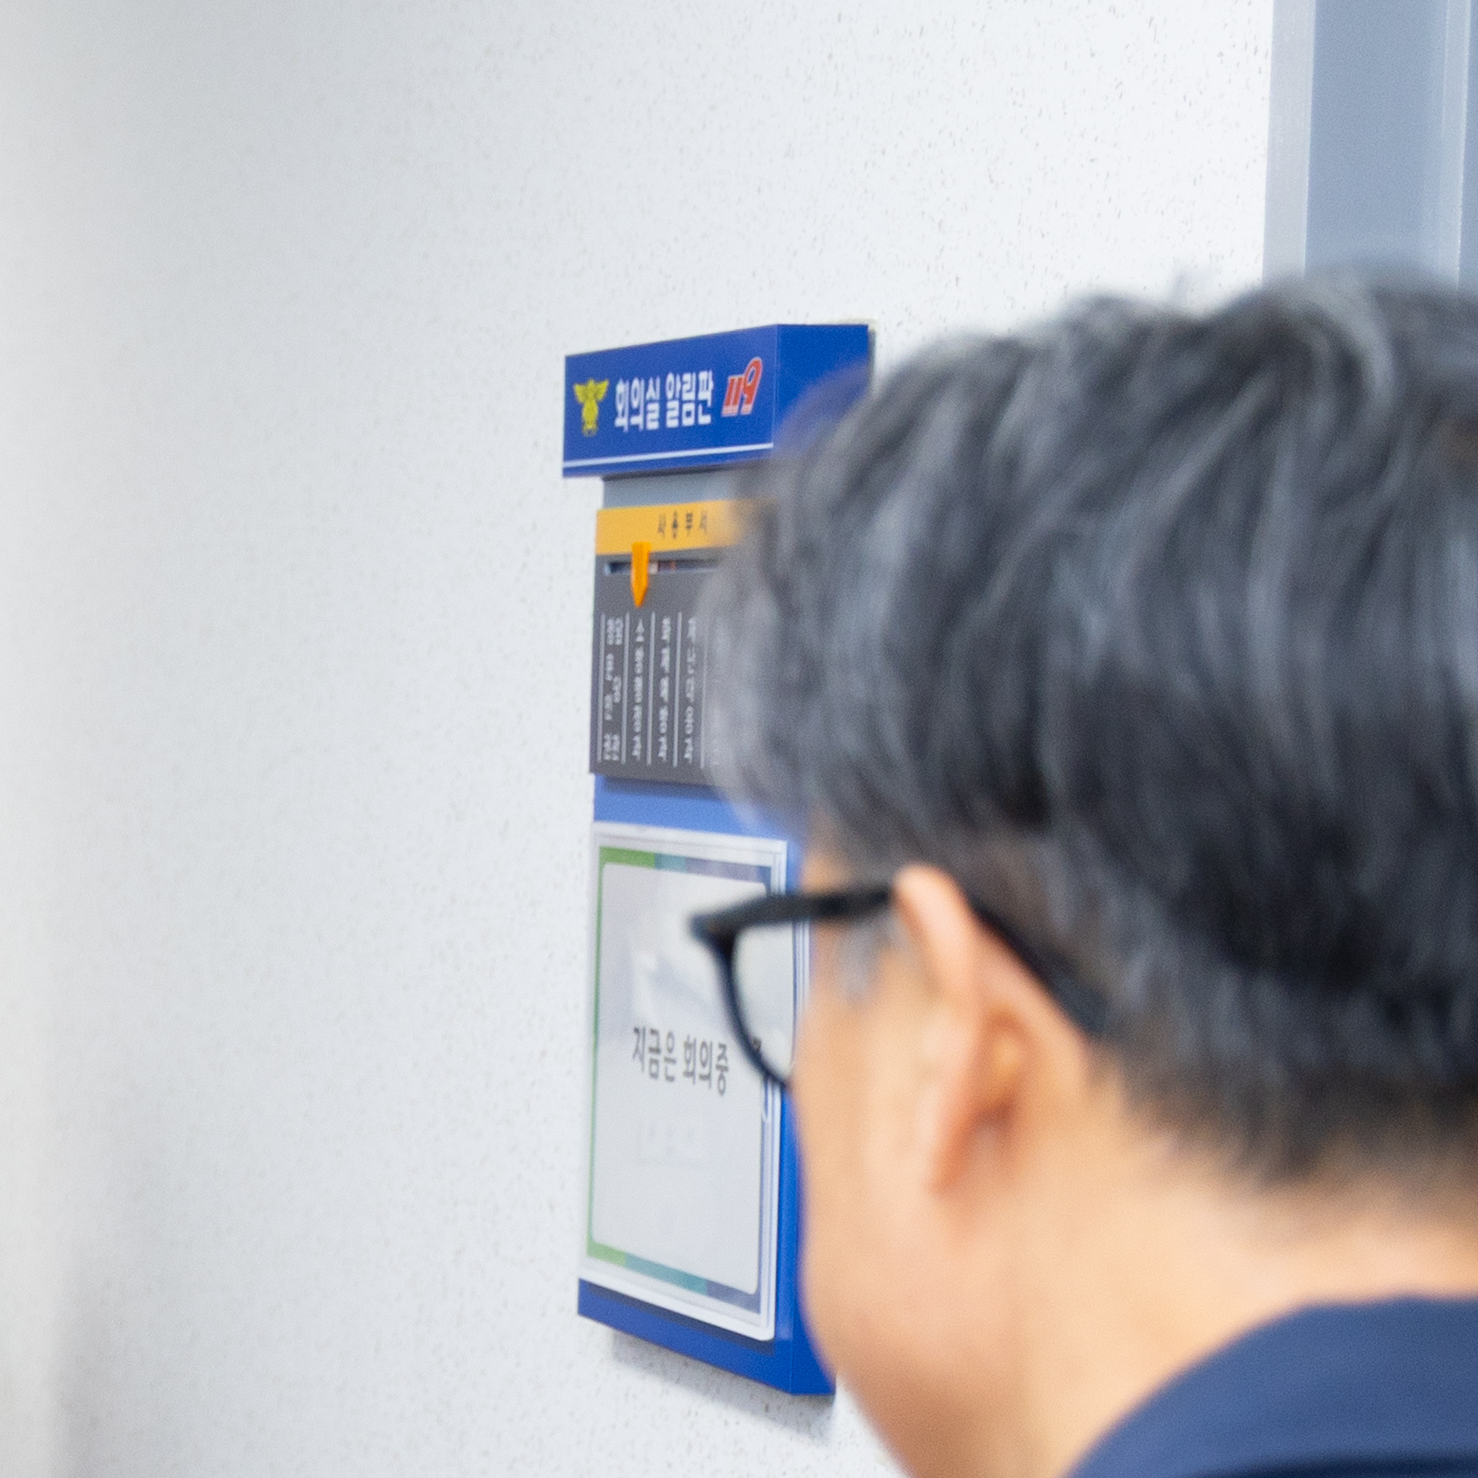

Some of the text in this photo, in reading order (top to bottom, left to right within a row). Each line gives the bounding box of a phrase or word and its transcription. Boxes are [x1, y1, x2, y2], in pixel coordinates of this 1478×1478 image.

[614, 357, 763, 433] 회의실 알림판 119
[632, 1026, 730, 1096] 지금은 회의중
